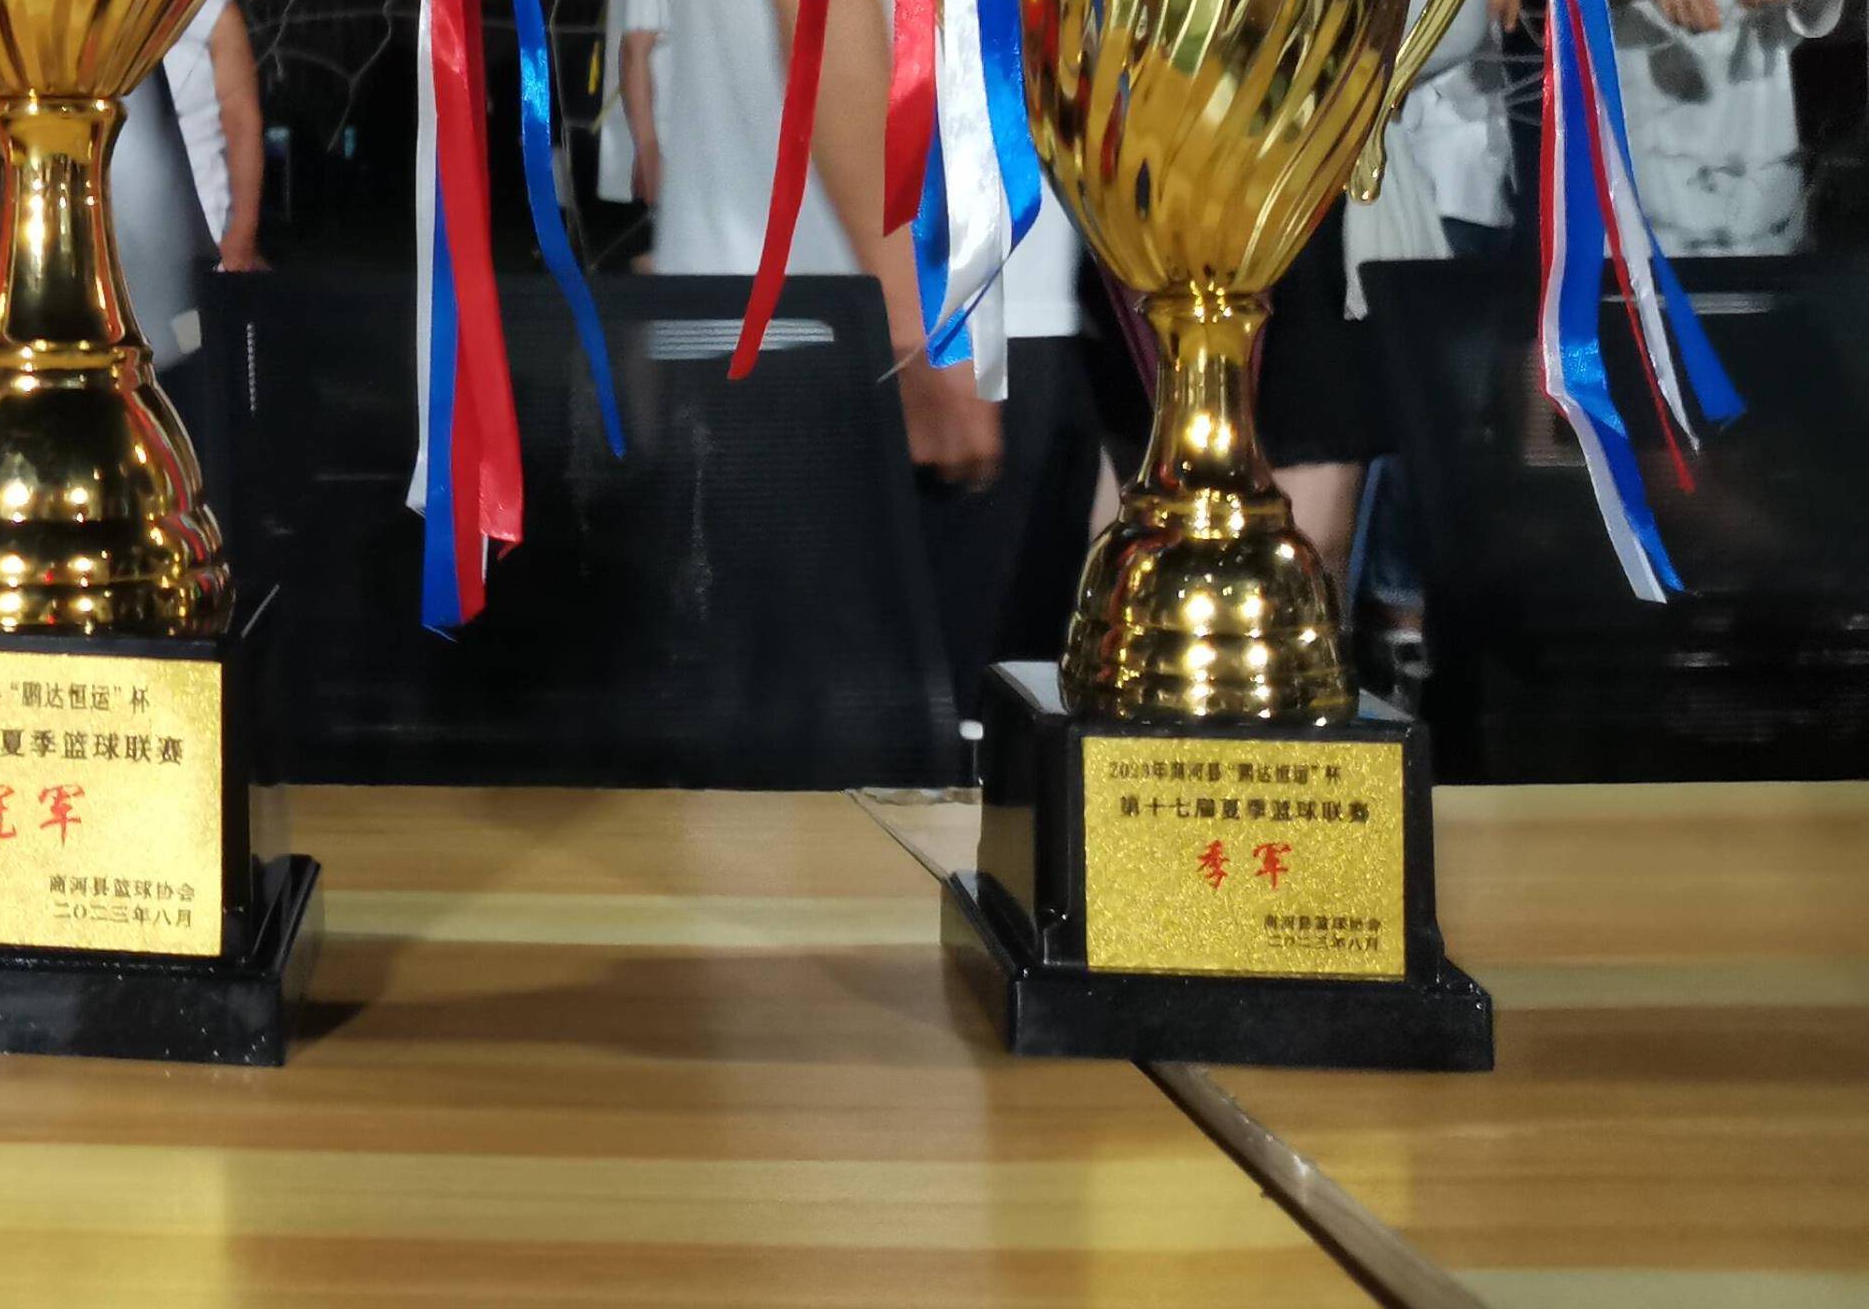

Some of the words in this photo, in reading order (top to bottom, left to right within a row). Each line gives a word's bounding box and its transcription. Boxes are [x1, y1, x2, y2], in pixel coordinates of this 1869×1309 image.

[1196, 839, 1293, 890] 季军
[49, 873, 195, 902] 商河县篮球协会
